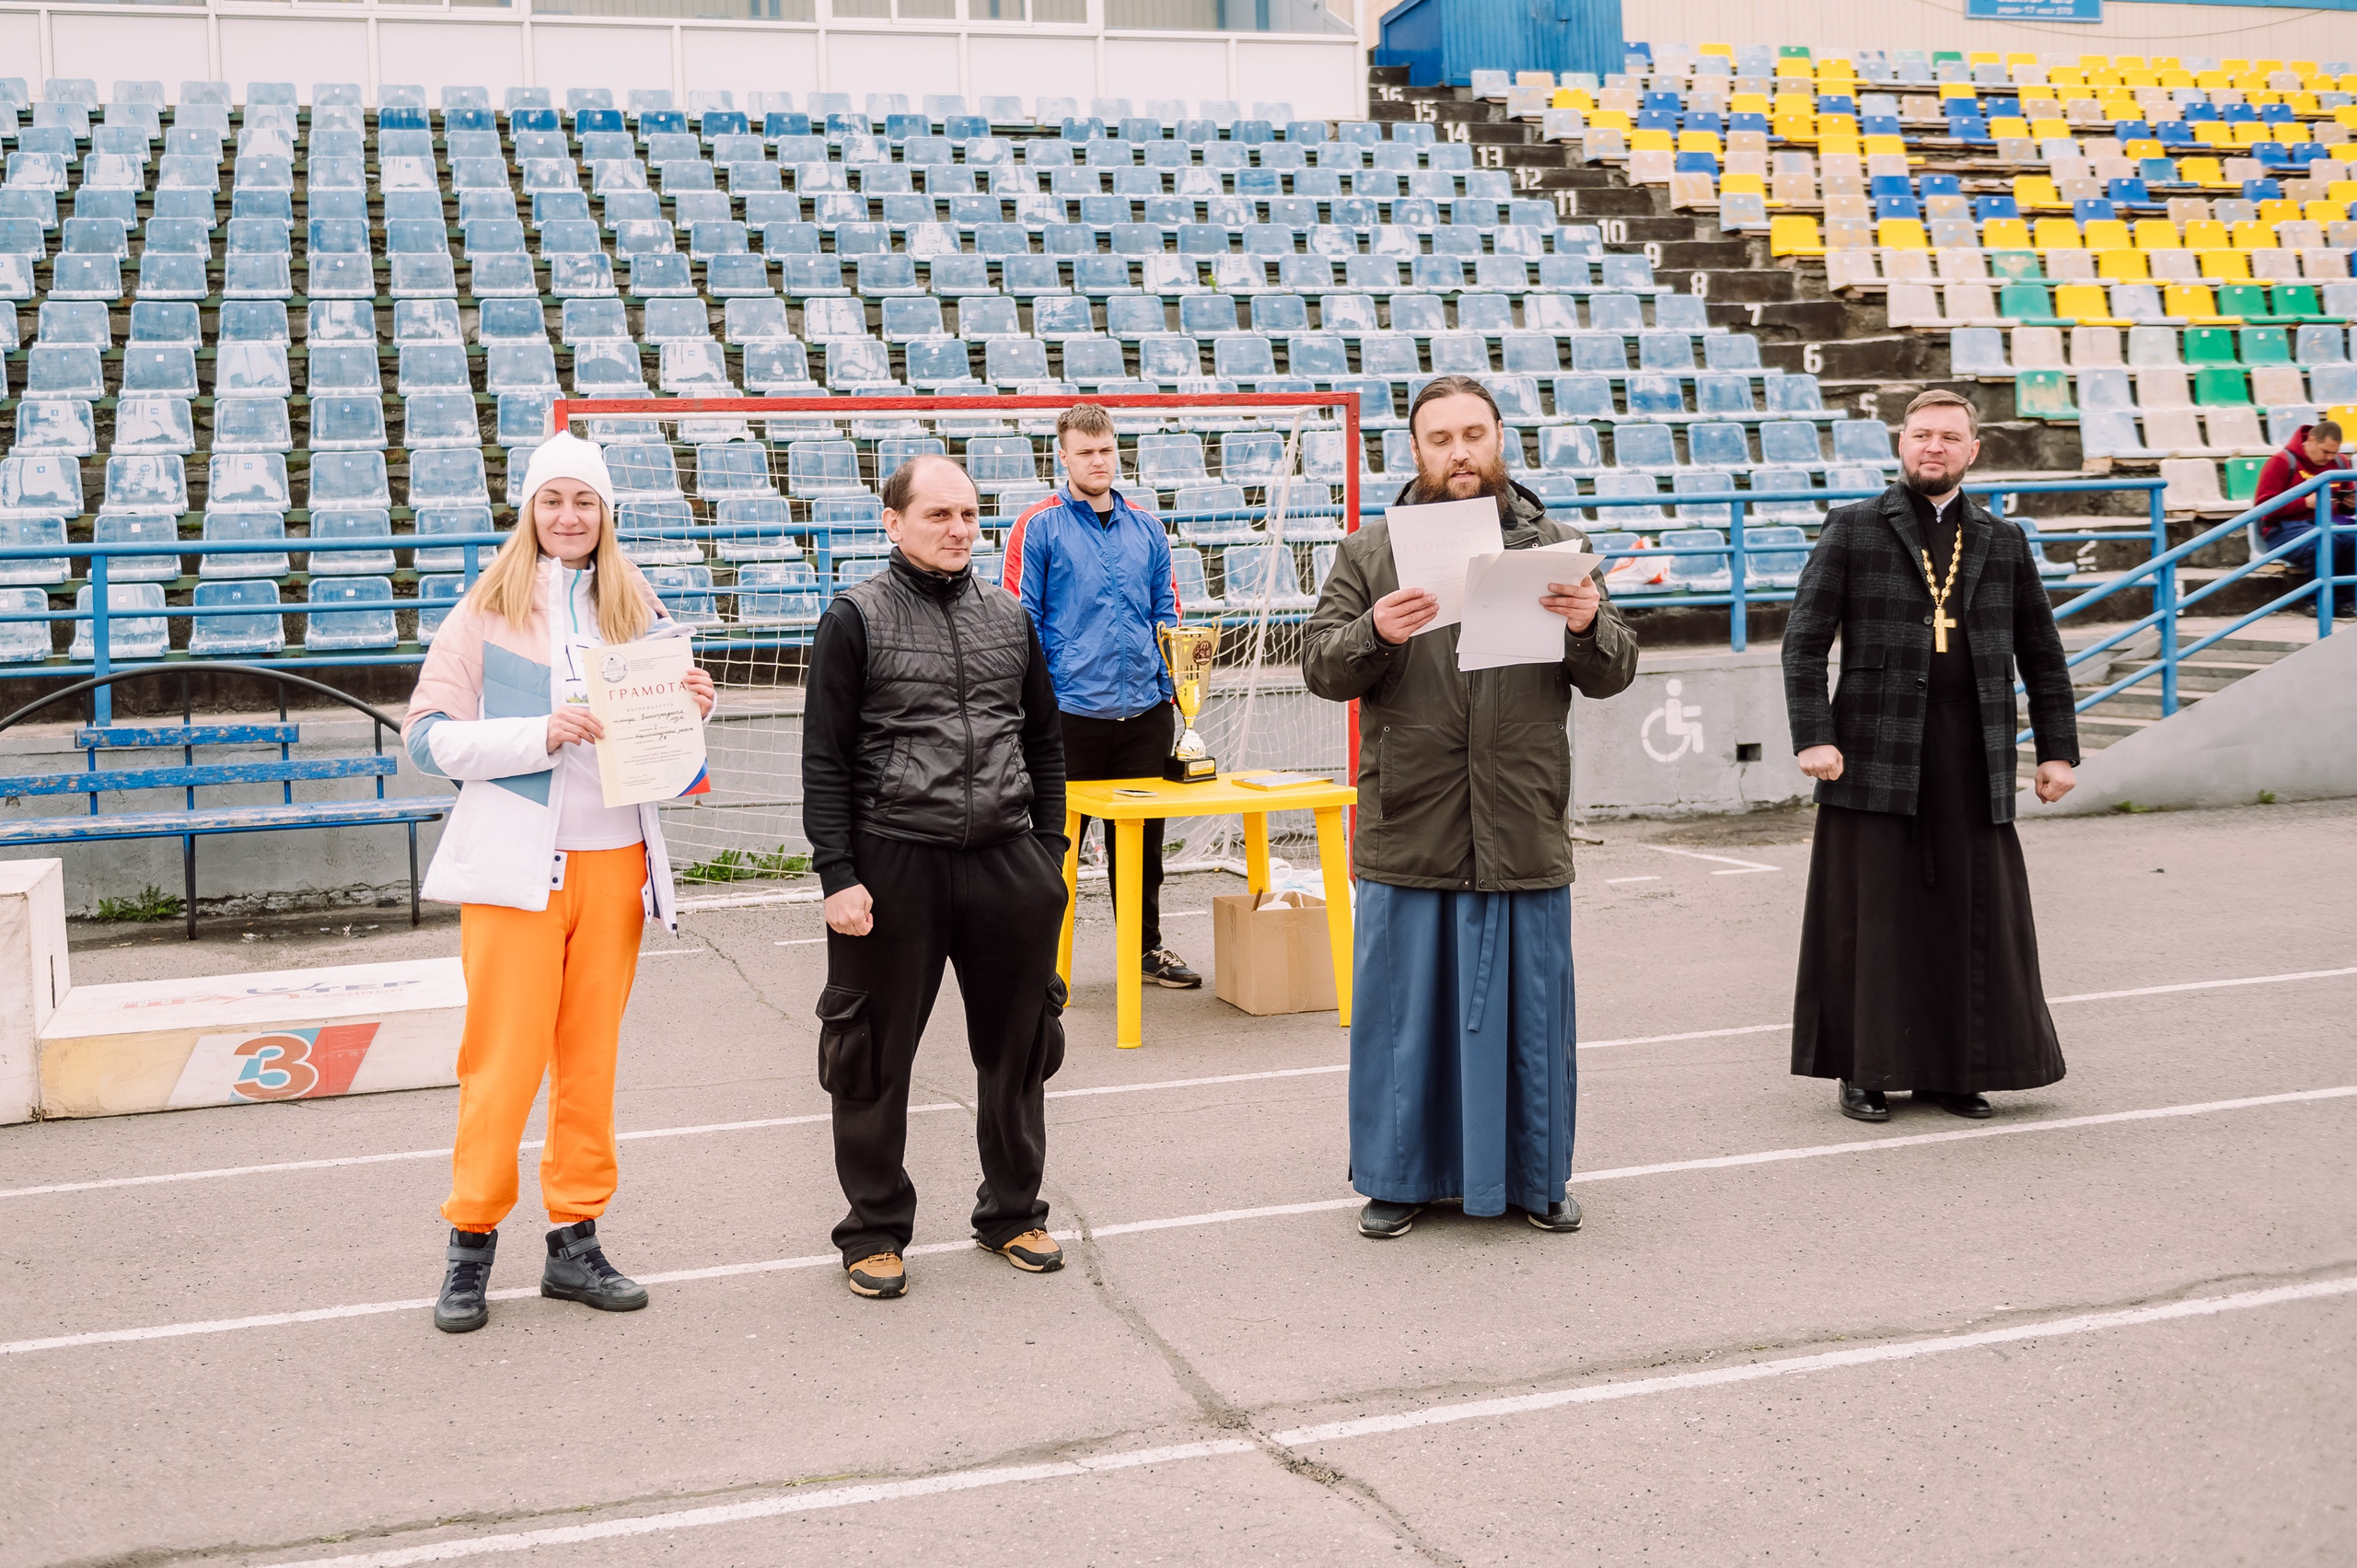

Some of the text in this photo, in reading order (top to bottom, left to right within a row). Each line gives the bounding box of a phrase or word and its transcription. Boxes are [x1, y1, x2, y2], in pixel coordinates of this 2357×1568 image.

[1377, 87, 1404, 101] 16
[1411, 99, 1437, 122] 15
[1443, 122, 1470, 144] 14
[1477, 145, 1504, 168] 13
[1515, 167, 1543, 190] 12
[1554, 190, 1577, 215] 11
[1596, 218, 1626, 243] 10
[1643, 242, 1661, 269] 9
[1690, 271, 1708, 298] 8
[1745, 304, 1764, 326] 7
[1803, 343, 1824, 374] 6
[609, 680, 688, 701] ГРАМОТА
[232, 1033, 319, 1100] 3
